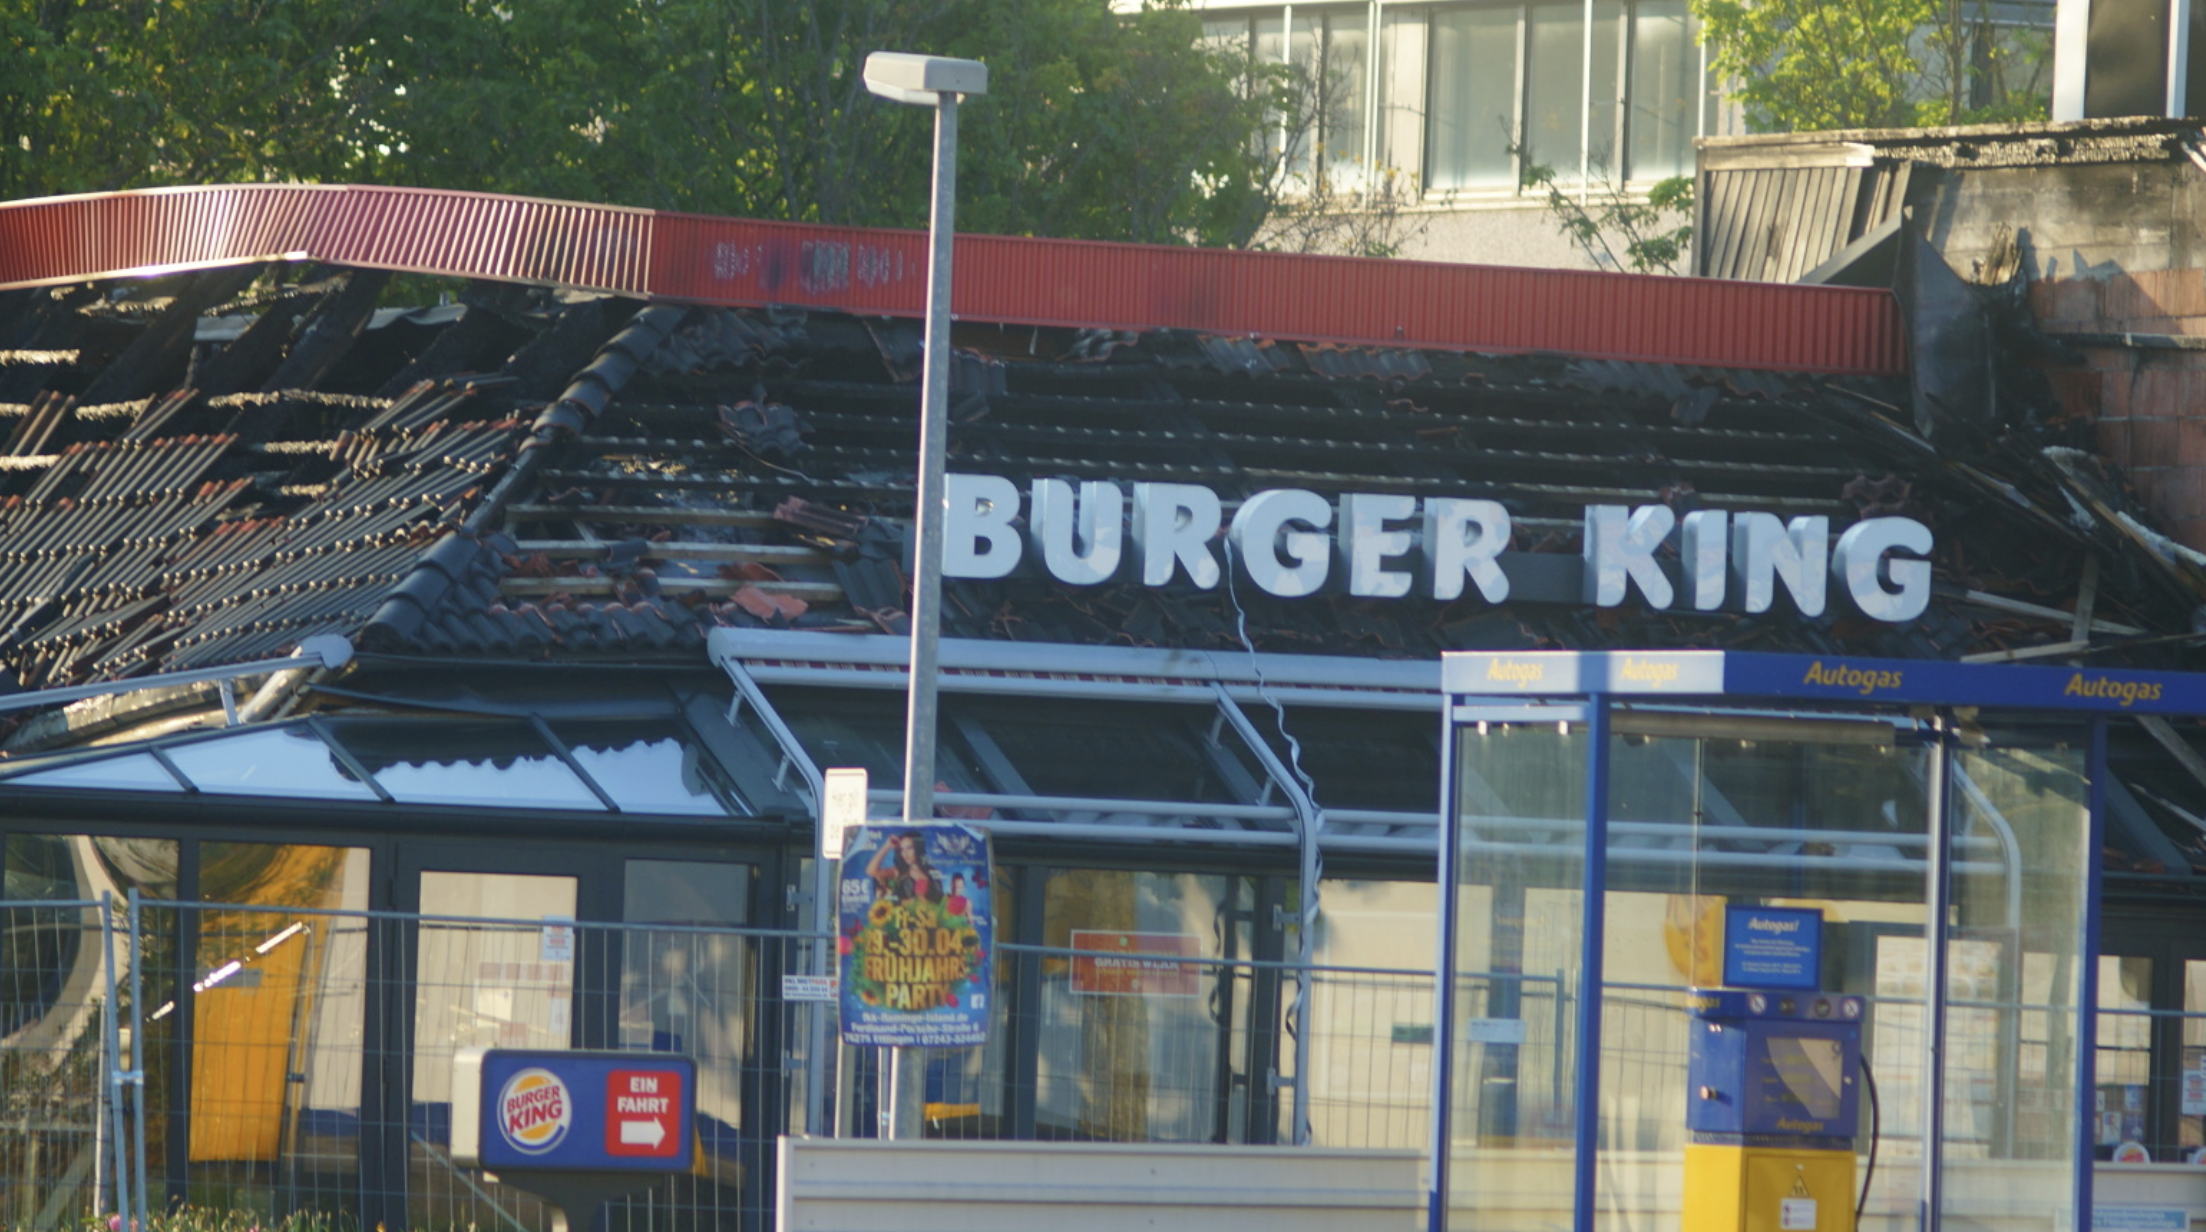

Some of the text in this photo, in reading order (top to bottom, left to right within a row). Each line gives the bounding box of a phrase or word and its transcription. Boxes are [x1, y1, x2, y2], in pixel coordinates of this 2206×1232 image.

[941, 473, 1934, 622] BURGER KING
[1487, 657, 1543, 688] Autogas
[1621, 656, 1678, 688] Autogas
[1803, 661, 1902, 695] Autogas
[2064, 672, 2163, 706] Autogas
[842, 879, 870, 895] 65€
[1747, 916, 1800, 935] Autogas!
[886, 984, 949, 1010] PARTY
[507, 1085, 560, 1114] BURGER
[629, 1076, 659, 1094] EIN
[509, 1100, 562, 1134] KING
[617, 1096, 669, 1114] FAHRT
[1776, 1115, 1825, 1133] Autogas
